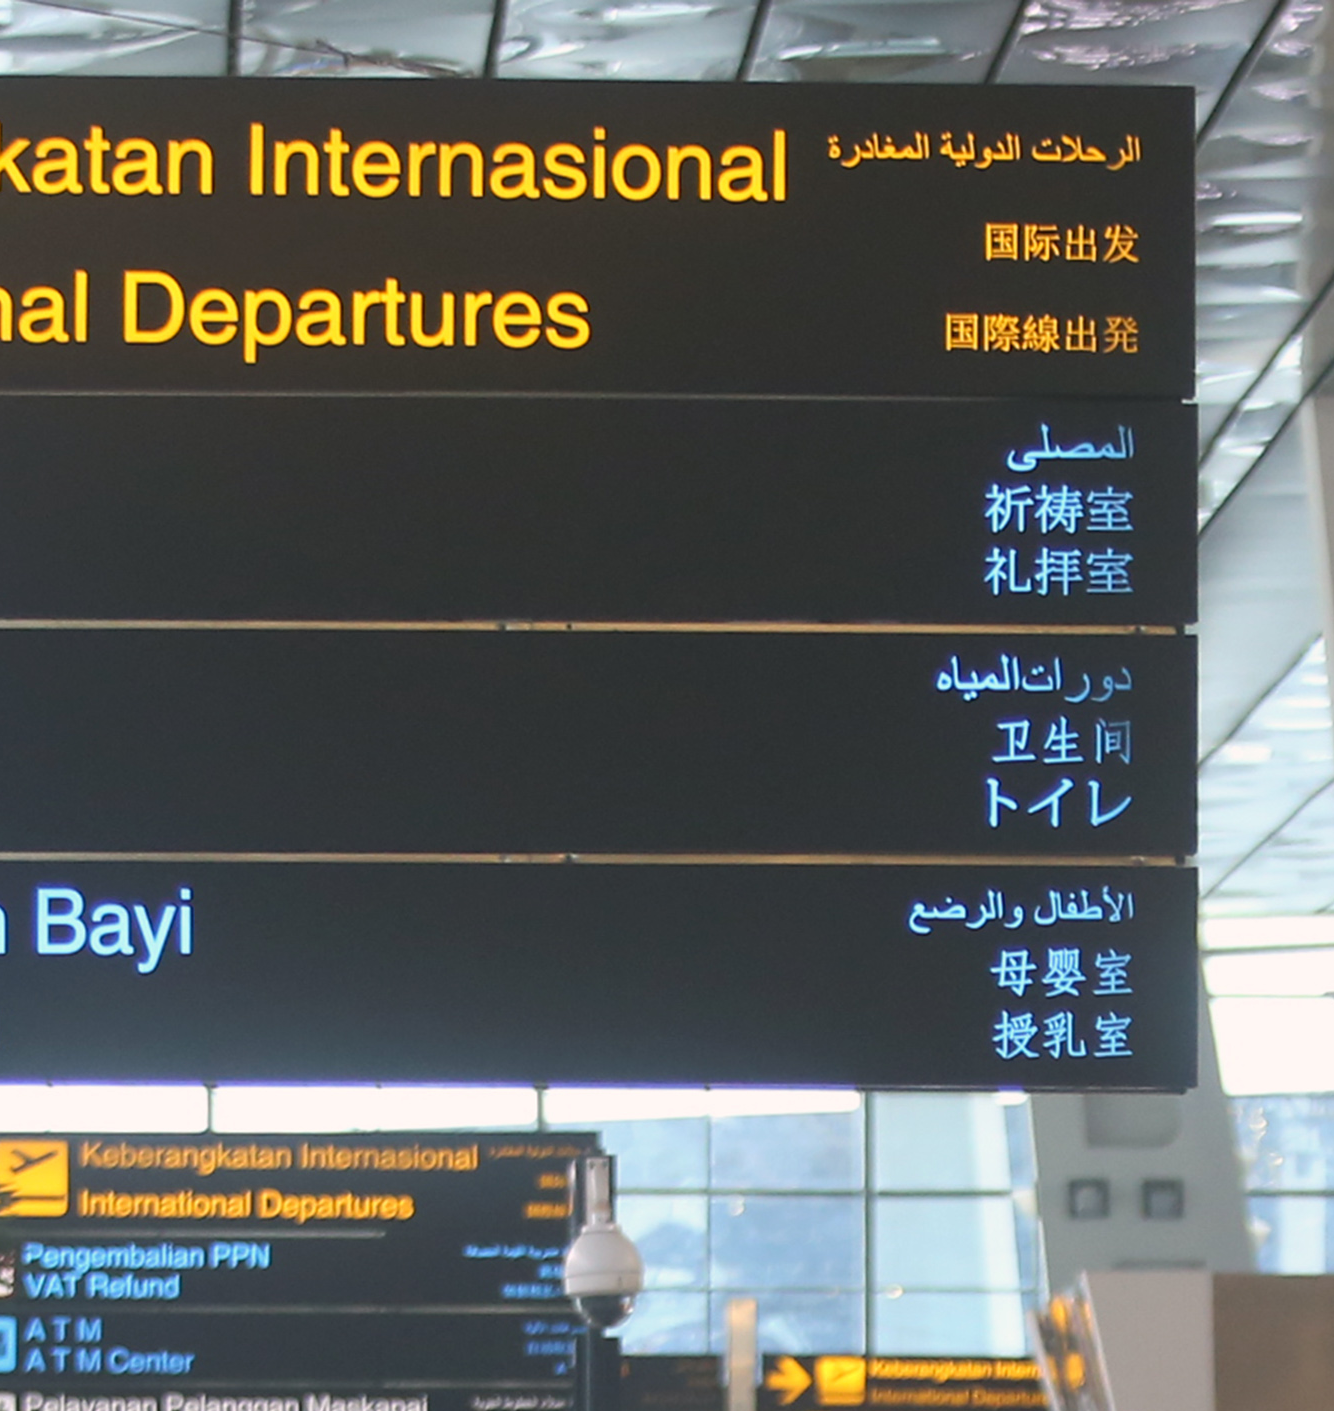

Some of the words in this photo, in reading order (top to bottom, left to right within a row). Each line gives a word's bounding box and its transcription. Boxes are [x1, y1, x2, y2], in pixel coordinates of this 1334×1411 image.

[248, 122, 786, 202] Internasional
[827, 131, 930, 168] المغادرة
[940, 131, 1021, 169] الدولية
[1032, 134, 1142, 171] الرحلات
[984, 222, 1140, 263] 国际出发
[122, 269, 591, 364] Departures
[945, 312, 1140, 354] 国際線出発
[1005, 422, 1135, 473] المصلى
[983, 483, 1135, 535] 祈祷室
[983, 545, 1135, 597] 礼拝室
[990, 714, 1132, 765] 卫生间
[984, 775, 1133, 828] トイレ
[1033, 884, 1135, 926] الأطفال
[32, 884, 193, 974] Bayi
[989, 945, 1134, 998] 母婴室
[991, 1008, 1134, 1060] 授乳室
[78, 1140, 294, 1177] Keberangkatan
[299, 1141, 479, 1171] Internasional
[77, 1187, 253, 1219] International
[256, 1187, 416, 1225] Departures
[21, 1241, 206, 1277] Pengembalian
[208, 1241, 272, 1269] PPN
[23, 1272, 81, 1299] VAT
[84, 1272, 182, 1300] Refund
[106, 1346, 197, 1375] Center
